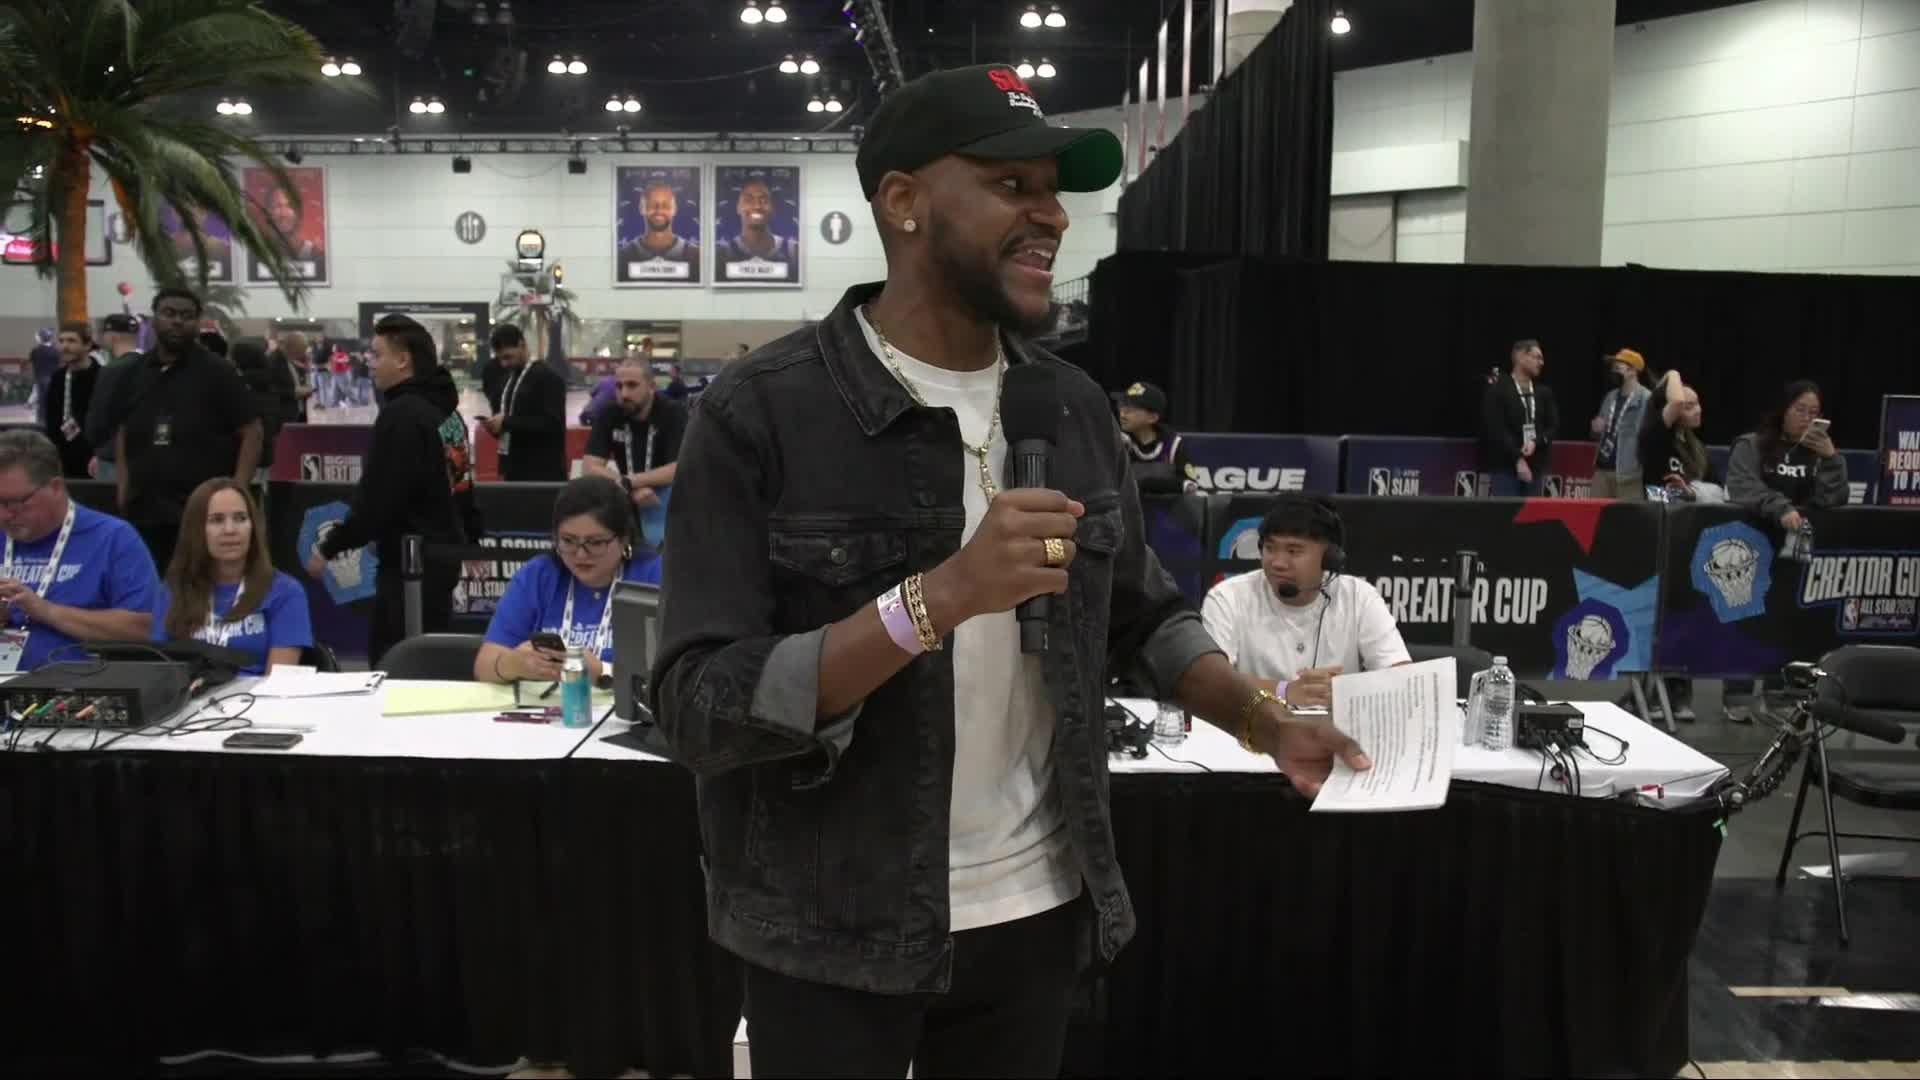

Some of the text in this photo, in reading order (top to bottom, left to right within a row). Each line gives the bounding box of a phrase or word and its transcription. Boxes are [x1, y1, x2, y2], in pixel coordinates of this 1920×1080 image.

[1889, 451, 1920, 470] REQU
[1194, 466, 1306, 491] AGUE
[1391, 478, 1420, 496] SLAM
[1803, 557, 1893, 603] CREATOR
[1376, 576, 1548, 624] CREATR CUP
[1875, 599, 1896, 615] STAR
